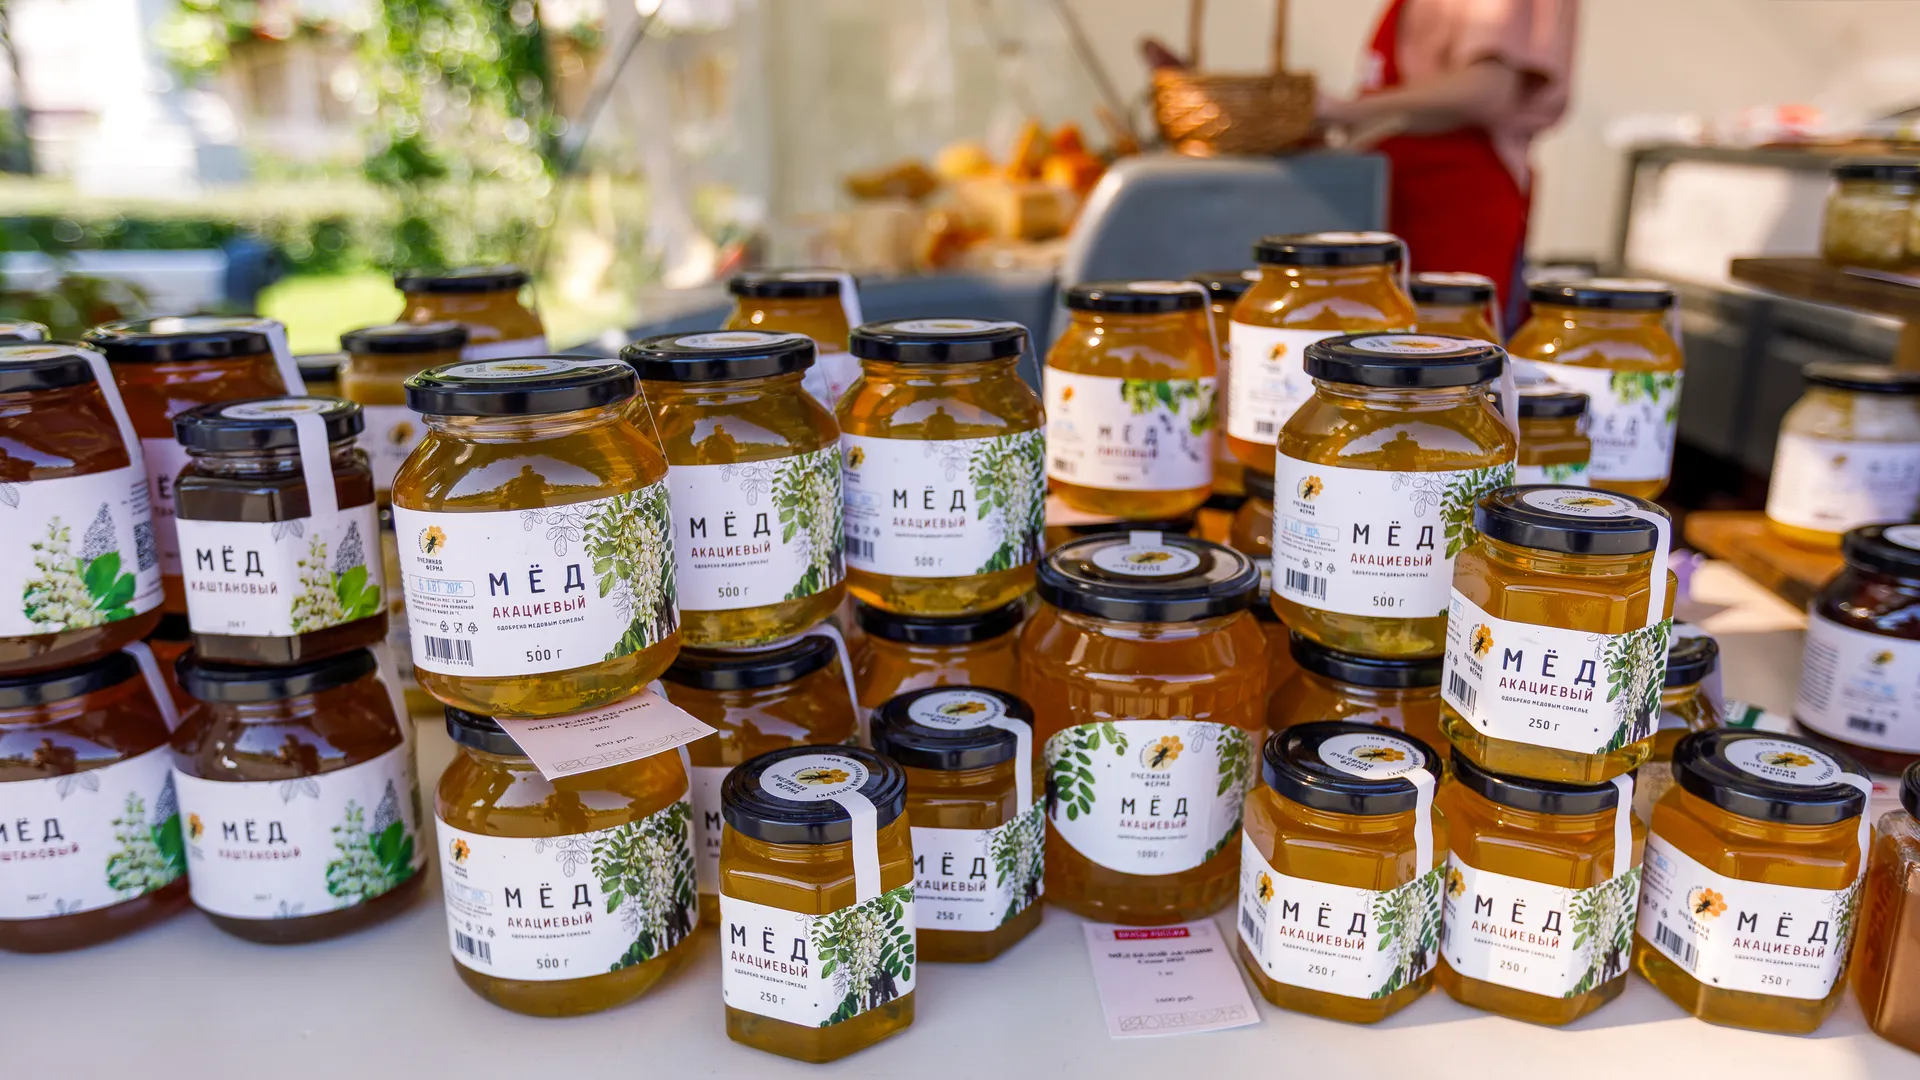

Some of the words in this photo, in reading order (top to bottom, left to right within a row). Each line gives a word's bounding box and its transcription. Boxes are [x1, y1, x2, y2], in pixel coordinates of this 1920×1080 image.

[893, 486, 966, 512] МЁД
[690, 510, 771, 538] МЁД
[893, 516, 966, 528] АКАЦИЕВЫЙ
[1352, 521, 1434, 550] МЁД
[691, 542, 772, 558] АКАЦИЕВЫЙ
[196, 546, 264, 577] МЁД
[416, 556, 442, 565] ПЧЕЛИНАЯ
[426, 564, 444, 572] ФЕРМА
[914, 556, 934, 567] 500
[1350, 554, 1432, 567] АКАЦИЕВЫЙ
[192, 580, 278, 596] КАШТАНОВЫЙ
[445, 581, 464, 594] 2025
[488, 563, 586, 597] МЁД
[718, 586, 740, 598] 500
[492, 594, 587, 619] АКАЦИЕВЫЙ
[1373, 596, 1394, 607] 500
[528, 620, 557, 629] МЕДОВЫМ
[558, 616, 585, 626] СОМЕЛЬЕ
[526, 649, 551, 662] 500
[1464, 652, 1483, 673] ПЧЕЛИНАЯ
[1470, 666, 1482, 680] ФЕРМА
[1502, 647, 1598, 687] МЁД
[1499, 676, 1594, 702] АКАЦИЕВЫЙ
[1502, 695, 1531, 705] ОДОБРЕНО
[1532, 700, 1561, 710] МЕДОВЫМ
[1562, 705, 1589, 714] СОМЕЛЬЕ
[1528, 718, 1550, 730] 250
[1330, 752, 1374, 768] ПЧЕЛИНАЯ
[1340, 760, 1369, 772] ФЕРМА
[1743, 761, 1796, 775] ПЧЕЛИНАЯ
[843, 761, 863, 786] НАТУРАЛЬНЫЙ
[1761, 768, 1796, 779] ФЕРМА
[771, 774, 808, 791] ПЧЕЛИНАЯ
[776, 783, 800, 794] ФЕРМА
[816, 786, 852, 798] ПРОДУКТ
[1121, 795, 1188, 818] МЁД
[222, 818, 287, 844] МЁД
[1120, 818, 1188, 829] АКАЦИЕВЫЙ
[916, 880, 986, 892] КАЦИЕВЫЙ
[504, 883, 592, 909] МЁД
[508, 912, 593, 928] АКАЦИЕВЫЙ
[936, 911, 954, 920] 250
[1282, 899, 1367, 938] МЁД
[1474, 894, 1562, 936] МЁД
[1472, 920, 1559, 948] АКАЦИЕВЫЙ
[1736, 911, 1830, 945] МЁД
[730, 922, 808, 965] МЁД
[1280, 926, 1365, 950] АКАЦИЕВЫЙ
[1282, 942, 1308, 952] ОДОБРЕНО
[1310, 948, 1337, 957] МЕДОВЫМ
[1338, 952, 1362, 962] СОМЕЛЬЕ
[1733, 936, 1825, 958] АКАЦИЕВЫЙ
[536, 958, 559, 969] 500
[731, 950, 808, 978] АКАЦИЕВЫЙ
[1308, 964, 1328, 976] 250
[1500, 960, 1520, 972] 250
[734, 968, 759, 978] ОДОБРЕНО
[760, 974, 784, 984] МЕДОВЫМ
[784, 980, 807, 990] СОМЕЛЬЕ
[1761, 974, 1782, 986] 250
[760, 991, 778, 1004] 250
